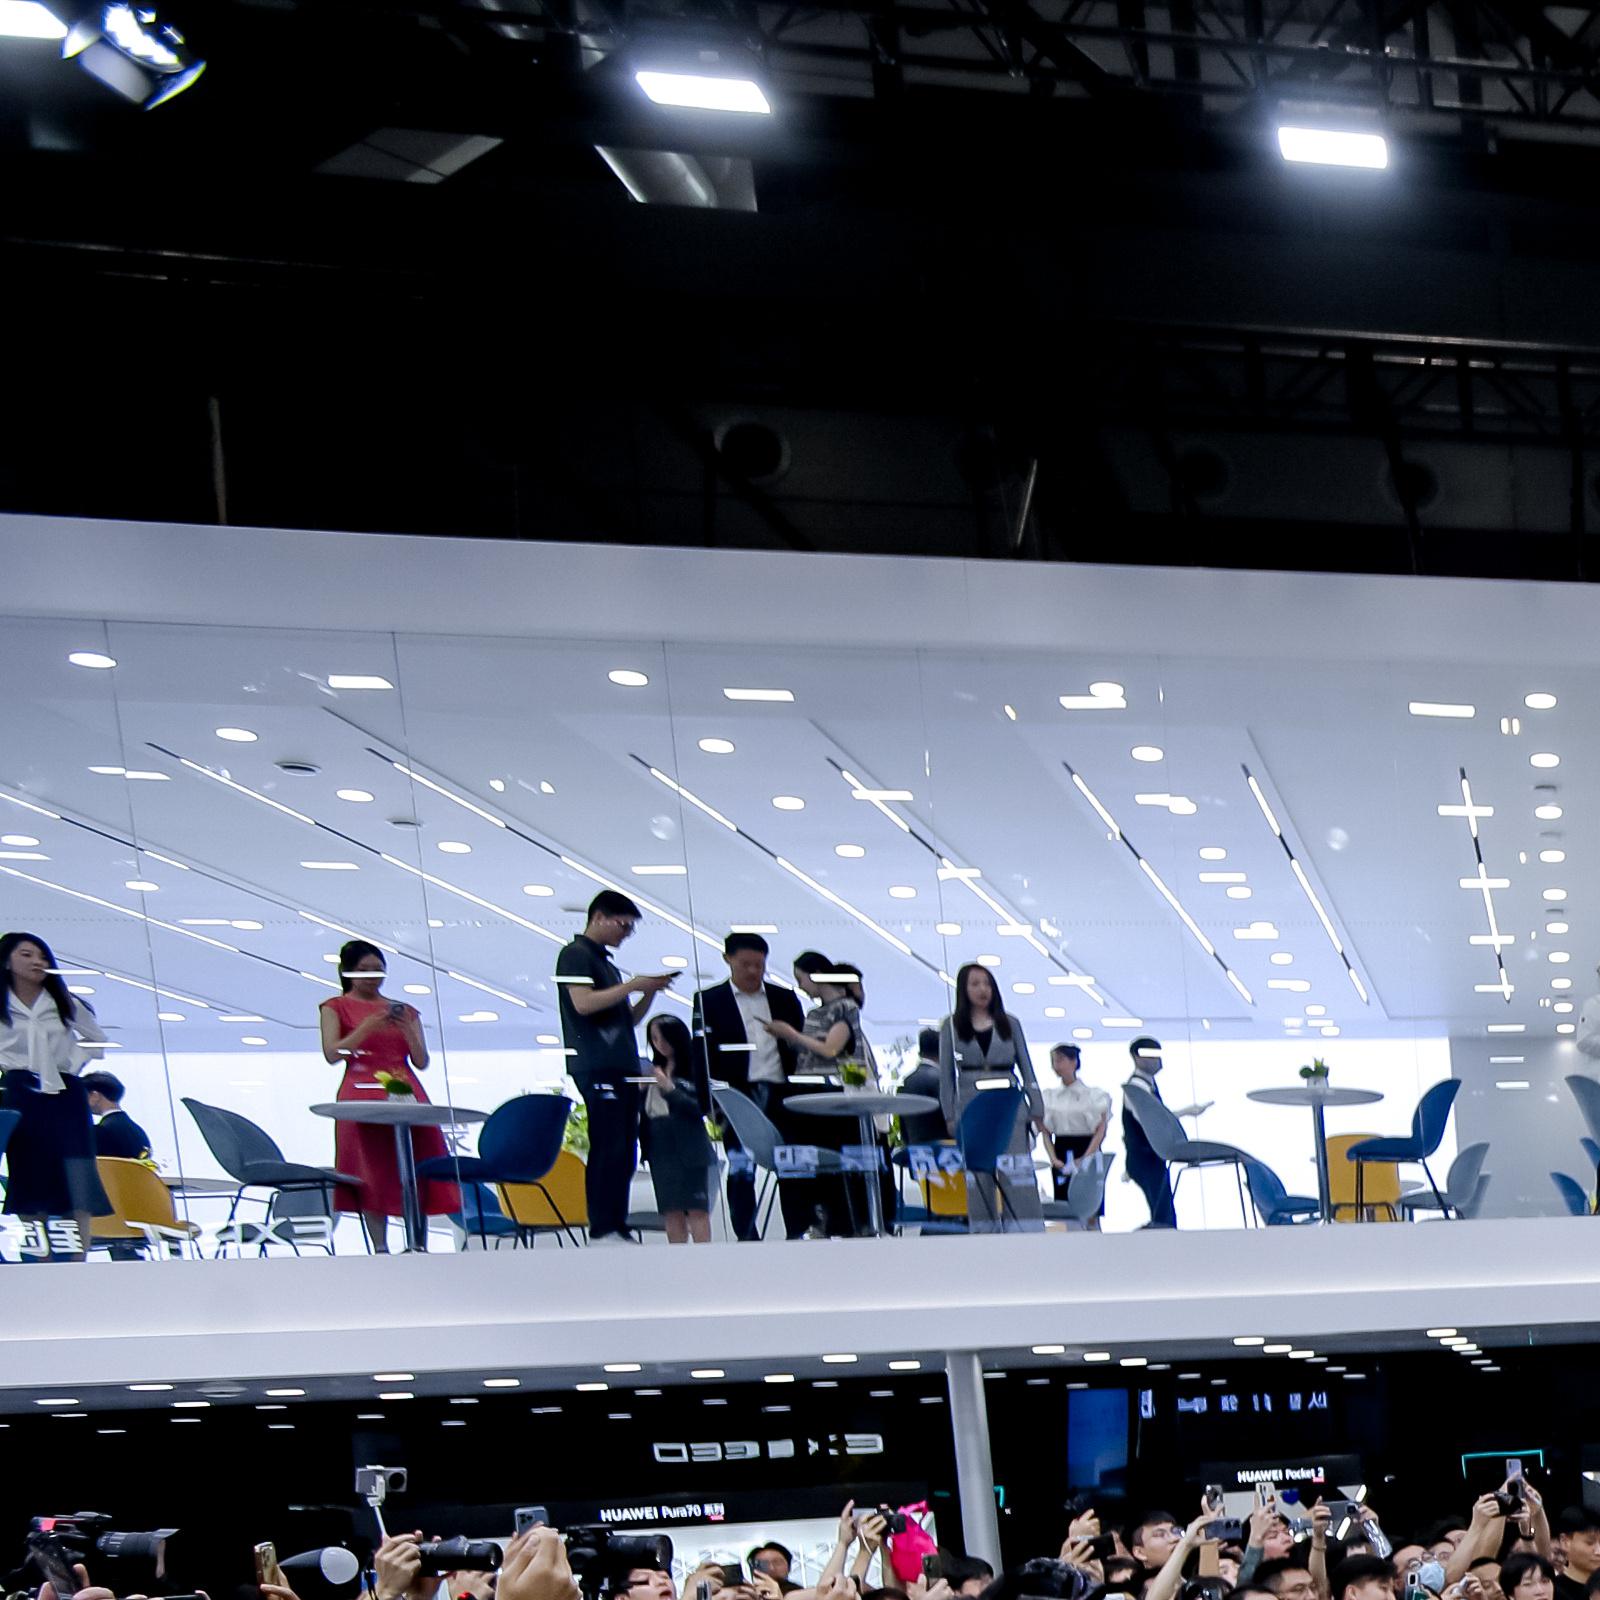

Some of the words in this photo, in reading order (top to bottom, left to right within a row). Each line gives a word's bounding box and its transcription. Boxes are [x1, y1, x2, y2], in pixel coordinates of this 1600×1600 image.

[1237, 1469, 1283, 1483] HUAWEI
[1285, 1467, 1315, 1480] Pocket
[600, 1507, 659, 1522] HUAWEI
